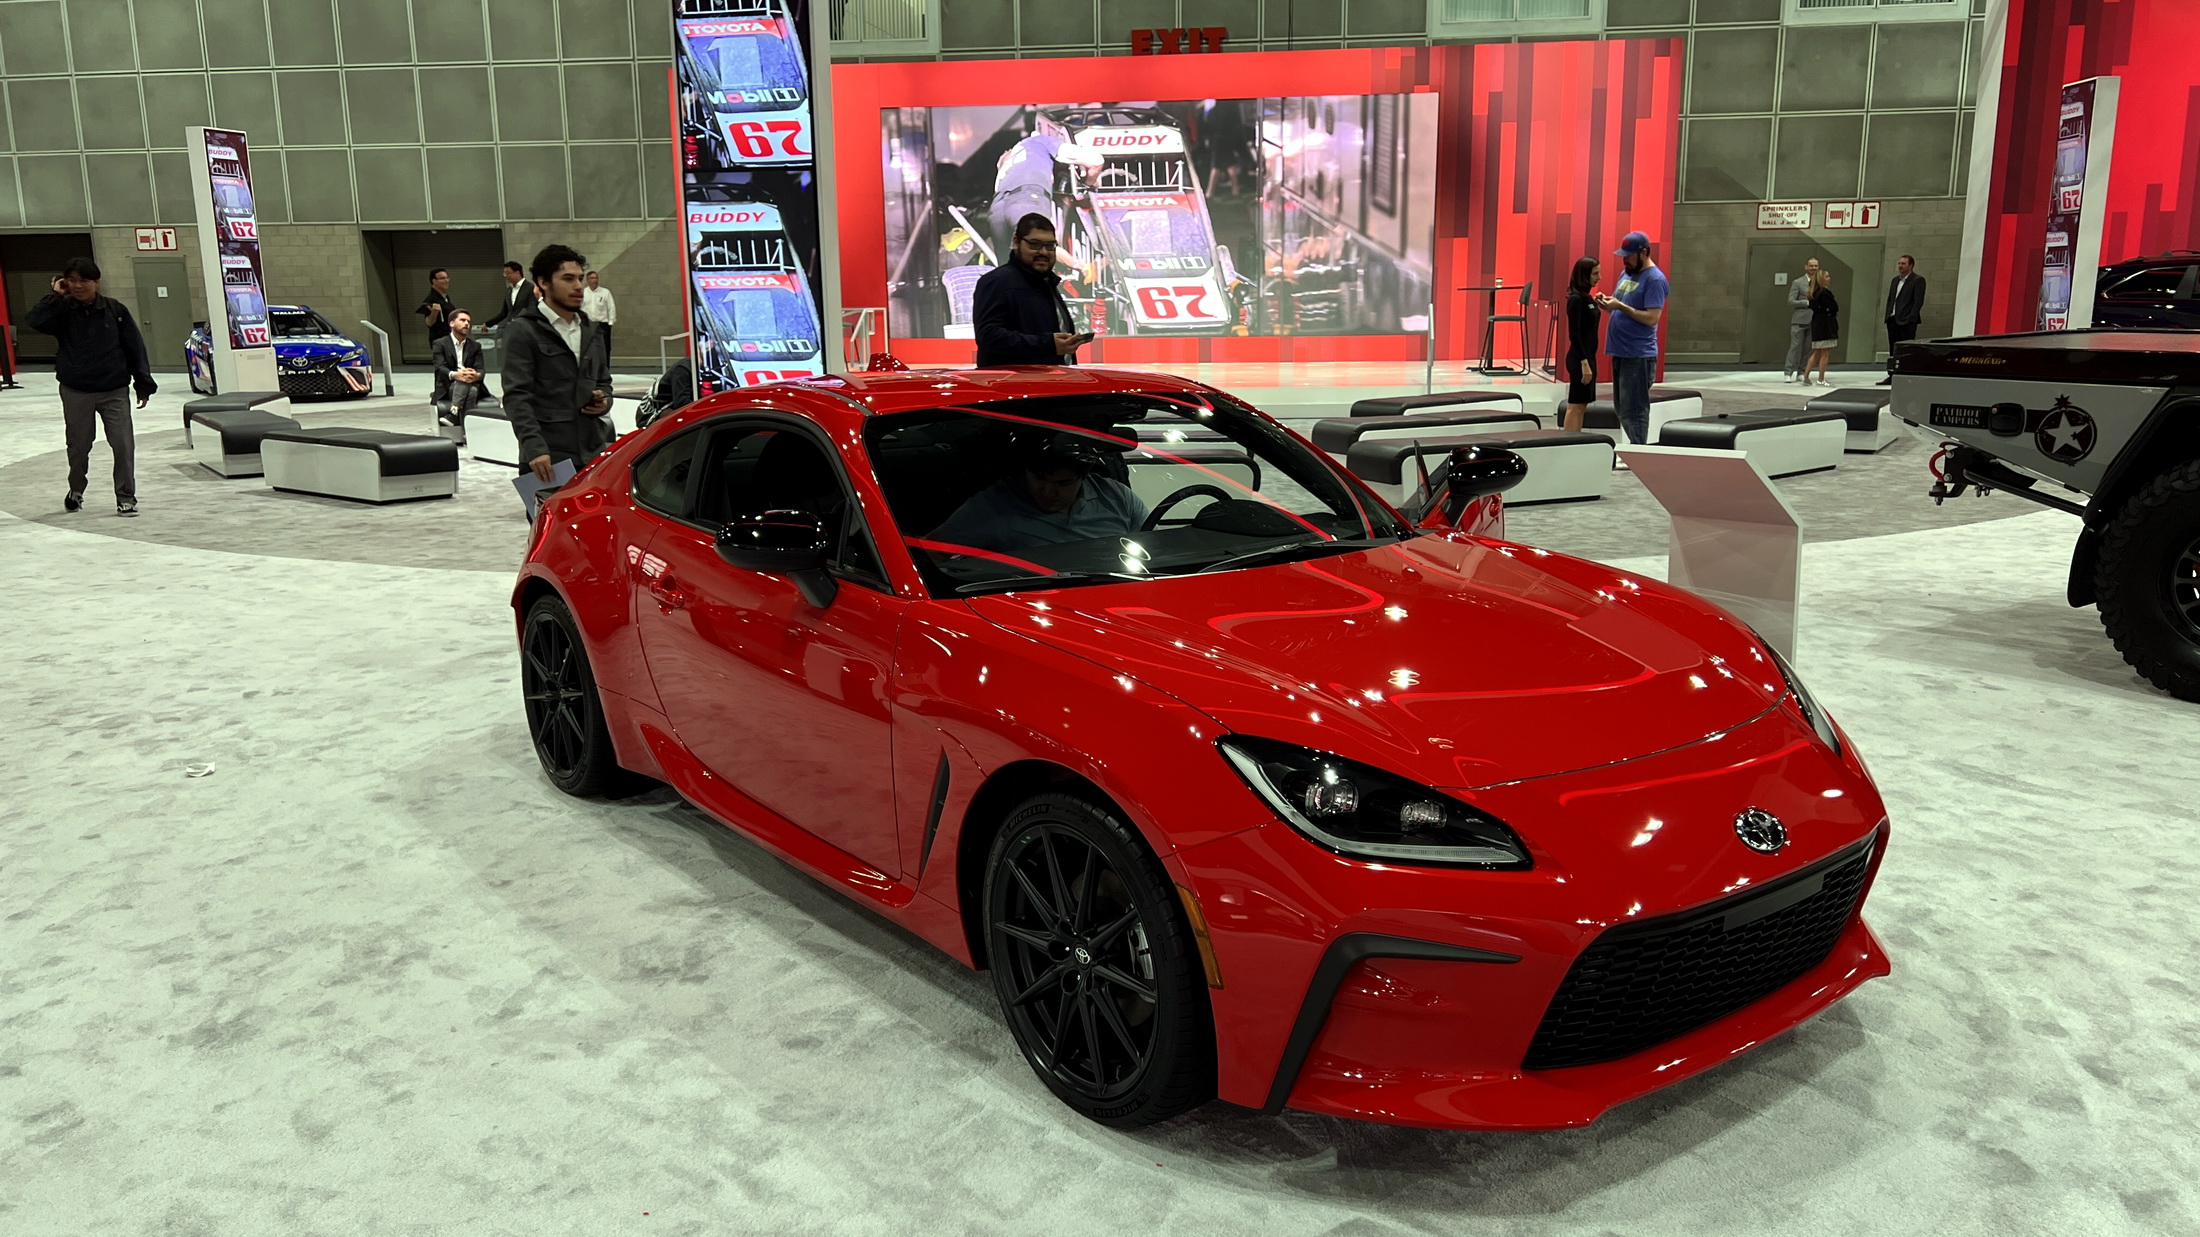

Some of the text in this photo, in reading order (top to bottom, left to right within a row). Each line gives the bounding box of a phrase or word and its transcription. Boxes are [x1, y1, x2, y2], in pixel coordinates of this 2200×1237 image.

[690, 22, 766, 34] TOYOTA
[1131, 27, 1227, 55] EXIT
[707, 36, 764, 89] 1
[707, 89, 773, 104] Mobil
[729, 121, 812, 157] 67
[1092, 134, 1168, 147] BUDDY
[222, 185, 240, 207] 1
[1104, 197, 1178, 207] TOYOTA
[2062, 190, 2080, 209] 67
[689, 212, 766, 224] BUDDY
[231, 221, 257, 237] 67
[1120, 210, 1172, 255] 1
[1117, 257, 1181, 270] Mobil
[705, 277, 780, 287] TOYOTA
[236, 294, 253, 315] 1
[1137, 286, 1217, 319] 67
[722, 290, 778, 338] 1
[244, 328, 269, 344] 67
[722, 339, 787, 353] Mobil
[1936, 407, 1982, 418] PATRIOT
[1935, 416, 1981, 426] CAMPERS
[1010, 804, 1047, 828] MICHELIN
